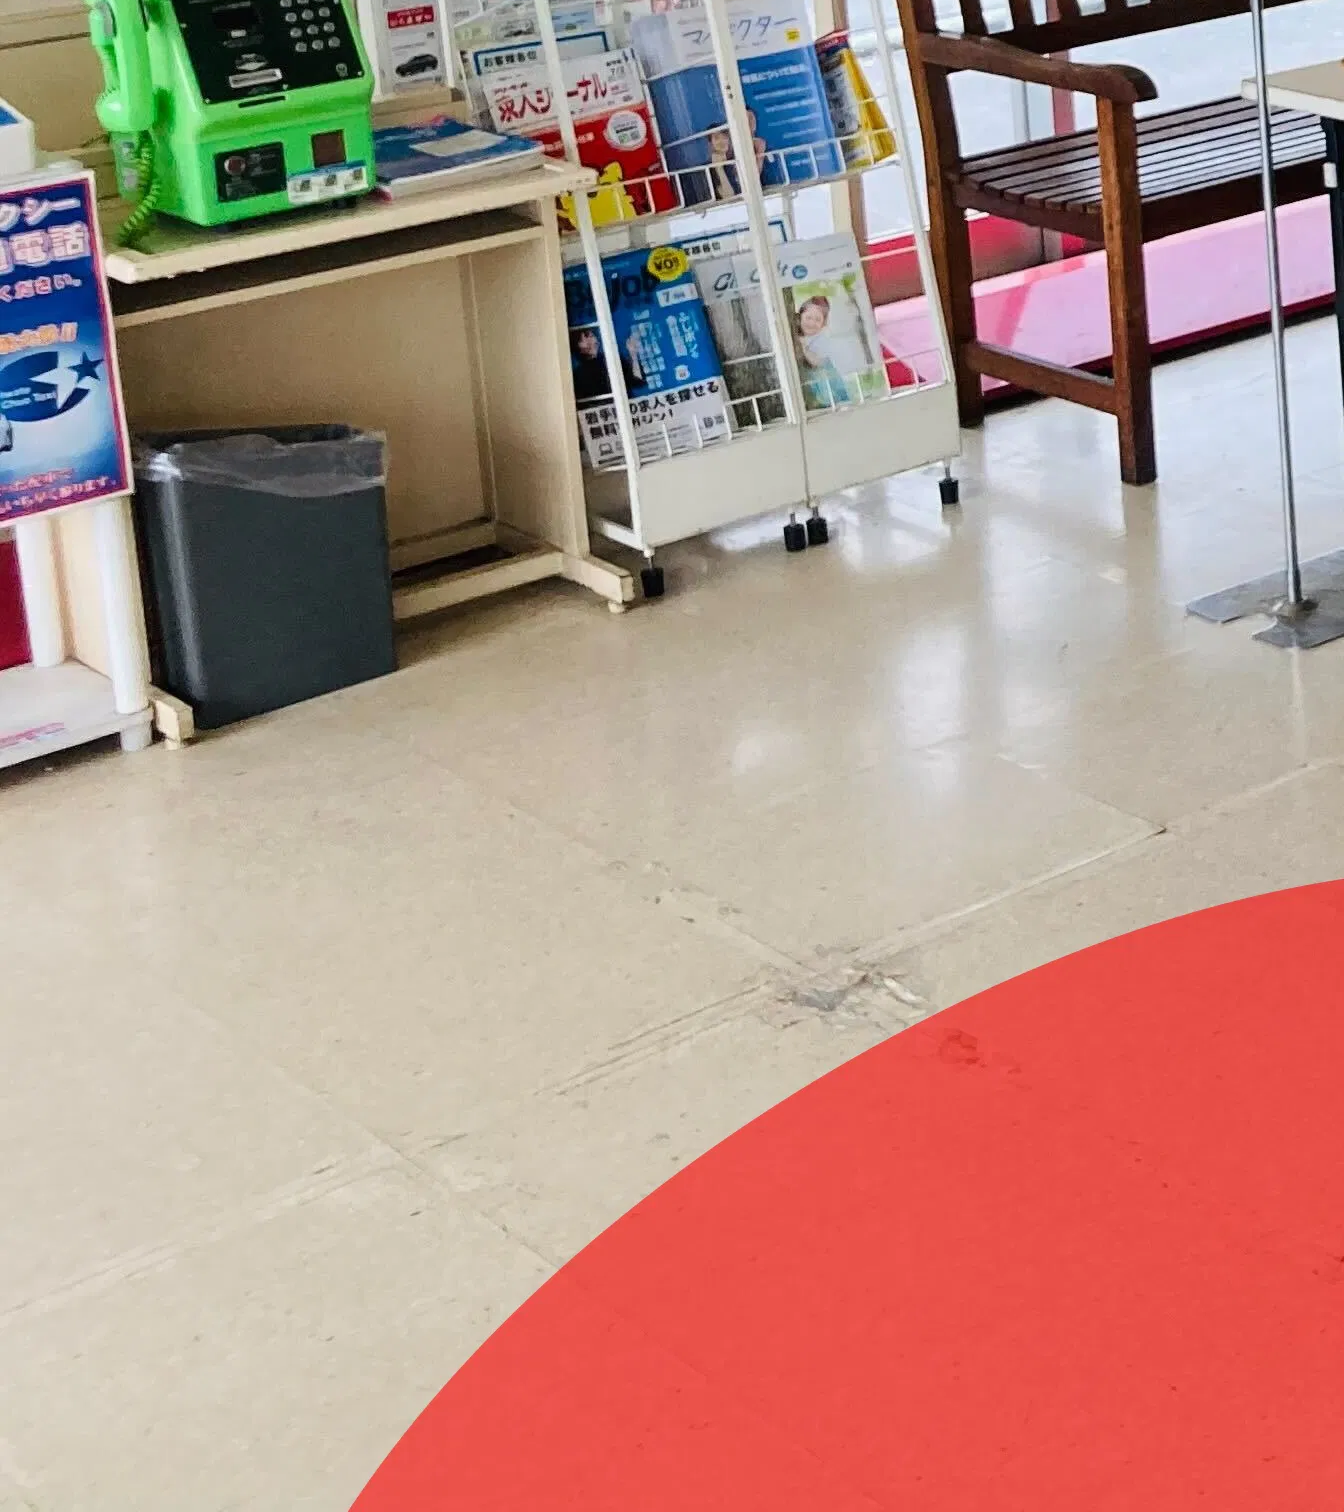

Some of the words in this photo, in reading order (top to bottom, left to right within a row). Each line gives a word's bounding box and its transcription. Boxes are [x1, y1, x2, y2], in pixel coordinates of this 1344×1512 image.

[498, 71, 608, 123] 求人ジーナル
